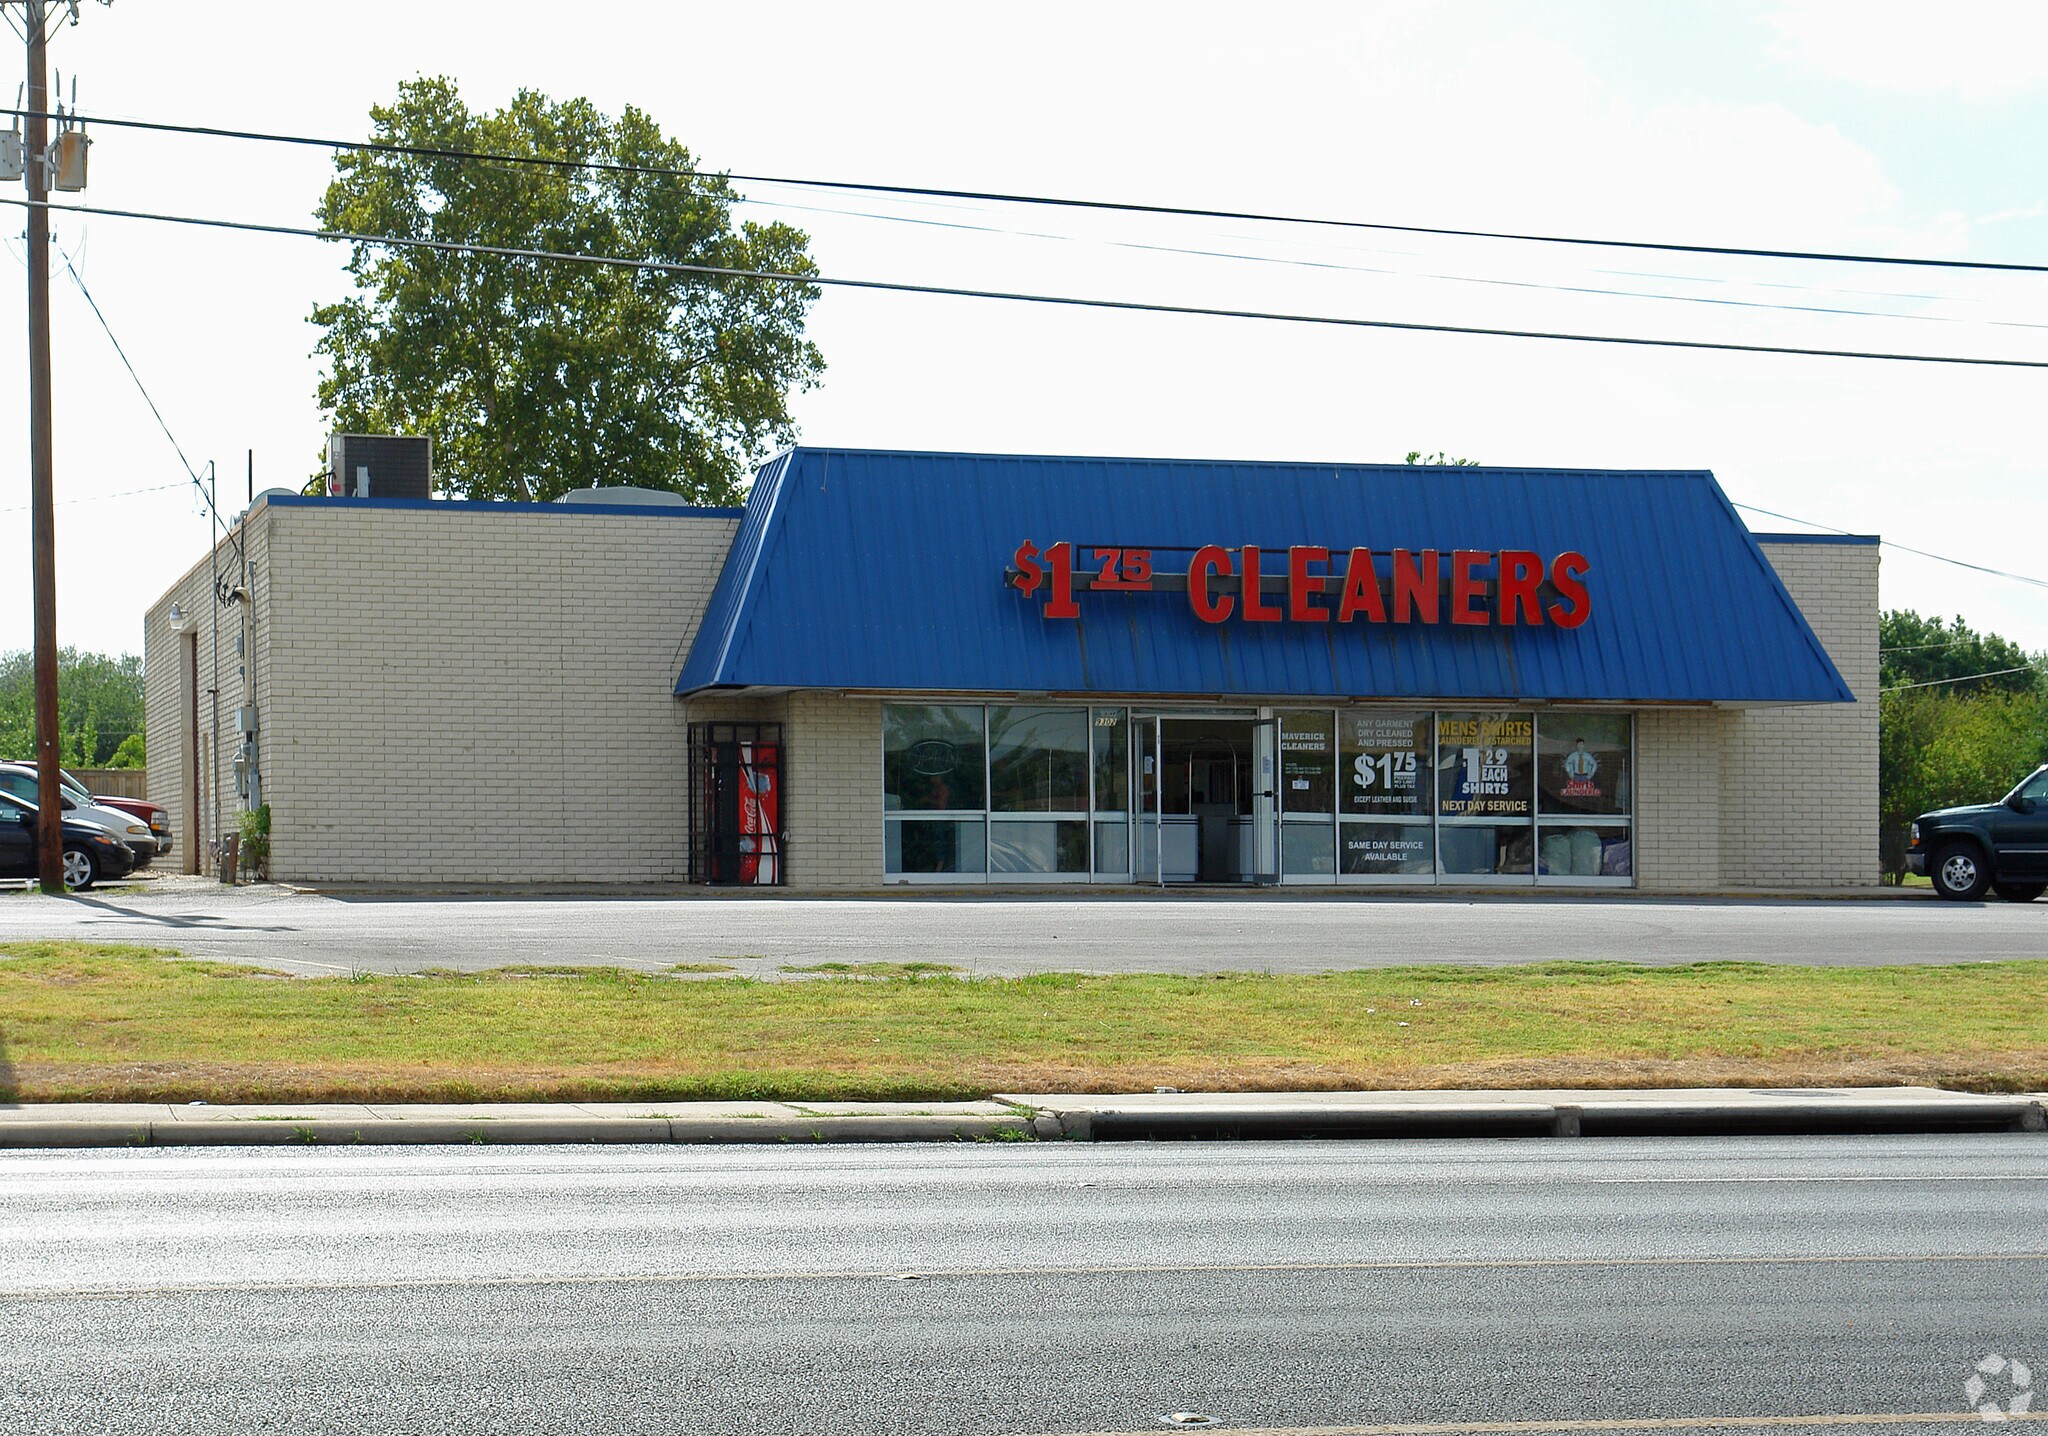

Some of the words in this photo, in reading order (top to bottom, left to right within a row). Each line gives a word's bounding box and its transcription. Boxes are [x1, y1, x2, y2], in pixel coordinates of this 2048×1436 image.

[1014, 540, 1079, 618] $1
[1092, 549, 1153, 582] 75
[1187, 544, 1592, 629] CLEANERS
[1439, 721, 1478, 736] MENS
[1481, 721, 1532, 736] SHIRTS
[1358, 739, 1375, 747] AND
[1377, 739, 1413, 747] PRESSED
[1492, 737, 1532, 745] STARCHED
[1353, 753, 1391, 789] $1
[1393, 751, 1417, 771] 75
[1482, 768, 1507, 781] EACH
[1462, 782, 1509, 794] SHIRTS
[1567, 780, 1594, 789] Shirts
[1442, 801, 1466, 811] NEXT
[1468, 801, 1486, 811] DAY
[1487, 801, 1527, 811] SERVICE
[1348, 841, 1371, 849] SAME
[1372, 841, 1388, 849] DAY
[1390, 841, 1424, 849] SERVICE
